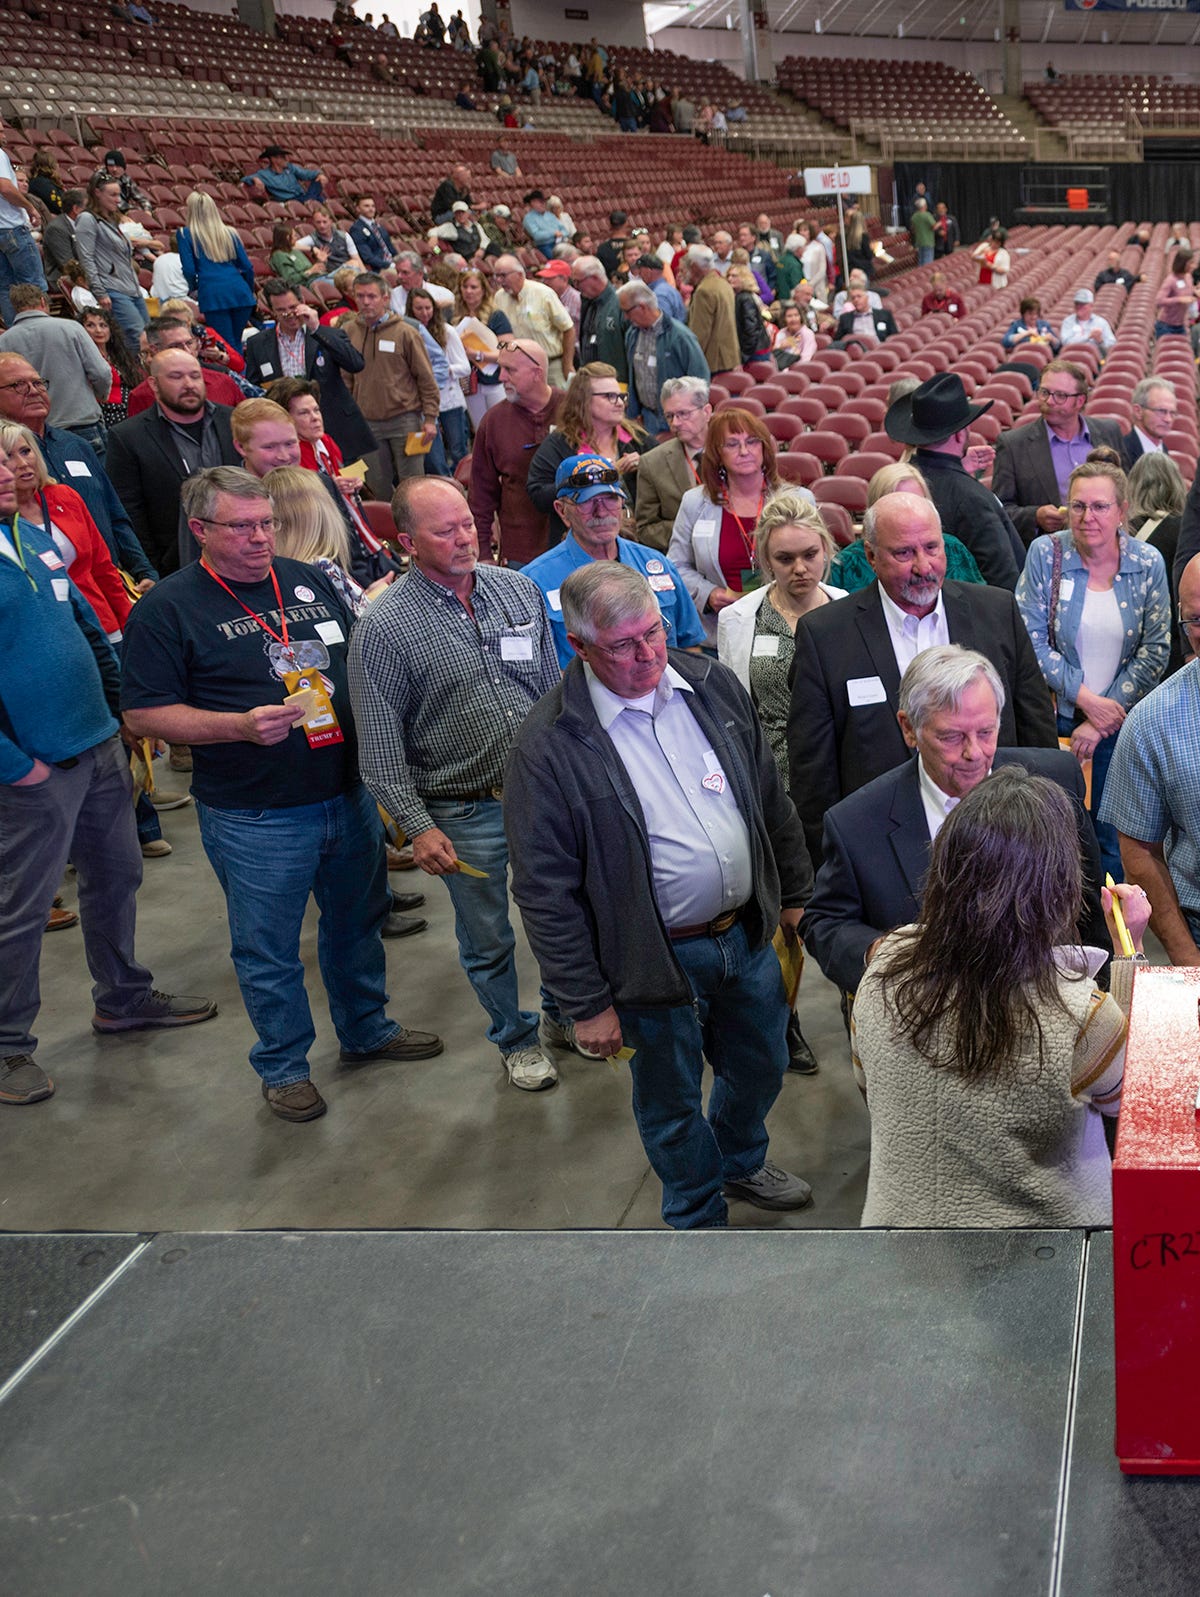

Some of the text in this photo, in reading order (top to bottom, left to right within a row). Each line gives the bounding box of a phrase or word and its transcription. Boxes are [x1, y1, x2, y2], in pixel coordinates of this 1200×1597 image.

[820, 171, 851, 188] WELD
[216, 613, 267, 640] TOB
[310, 732, 333, 743] TRUMP
